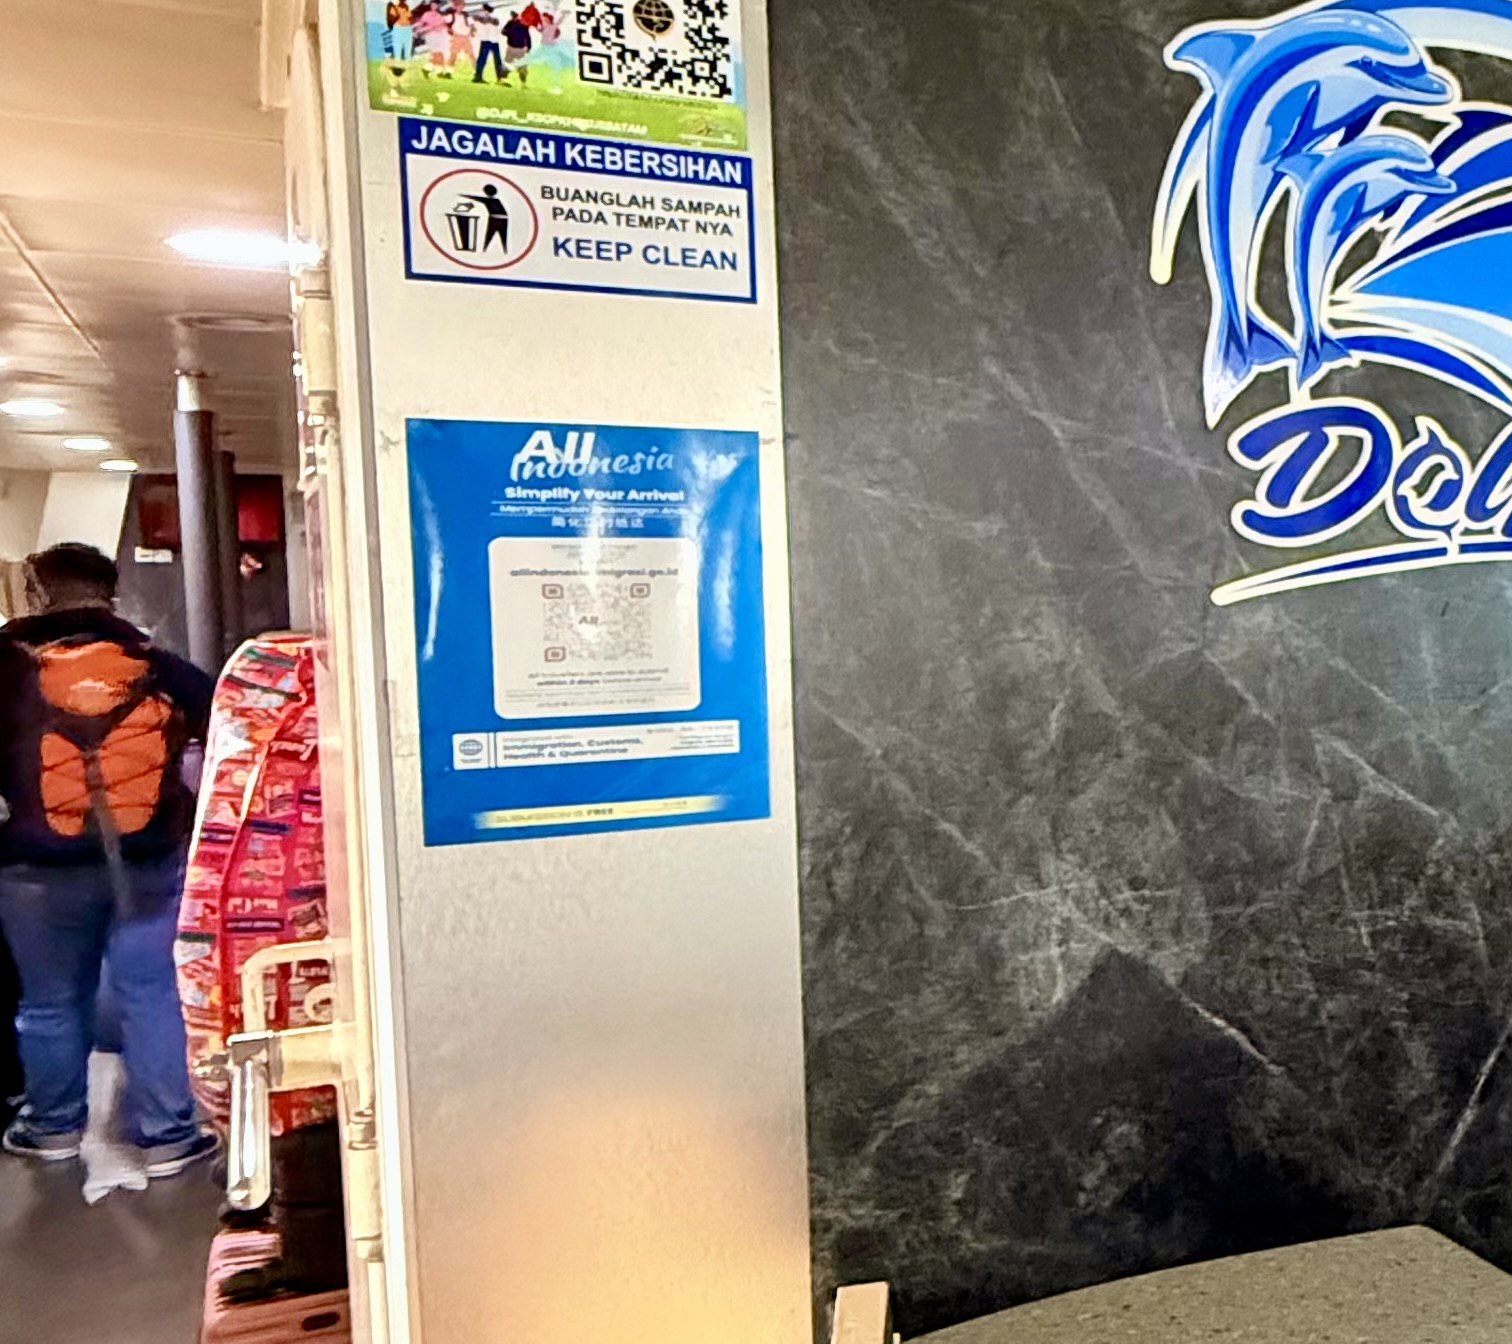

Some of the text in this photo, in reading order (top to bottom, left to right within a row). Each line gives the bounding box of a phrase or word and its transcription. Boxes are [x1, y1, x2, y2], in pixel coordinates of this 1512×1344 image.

[411, 125, 742, 184] JAGALAH KEBERSIHAN
[540, 185, 741, 218] BUANGLAH SAMPAH
[552, 207, 733, 237] PADA TEMPAT NYA
[553, 237, 738, 271] KEEP CLEAN
[510, 446, 674, 482] Indonesia
[517, 430, 596, 465] All
[504, 486, 685, 502] Simplify Your Arrival
